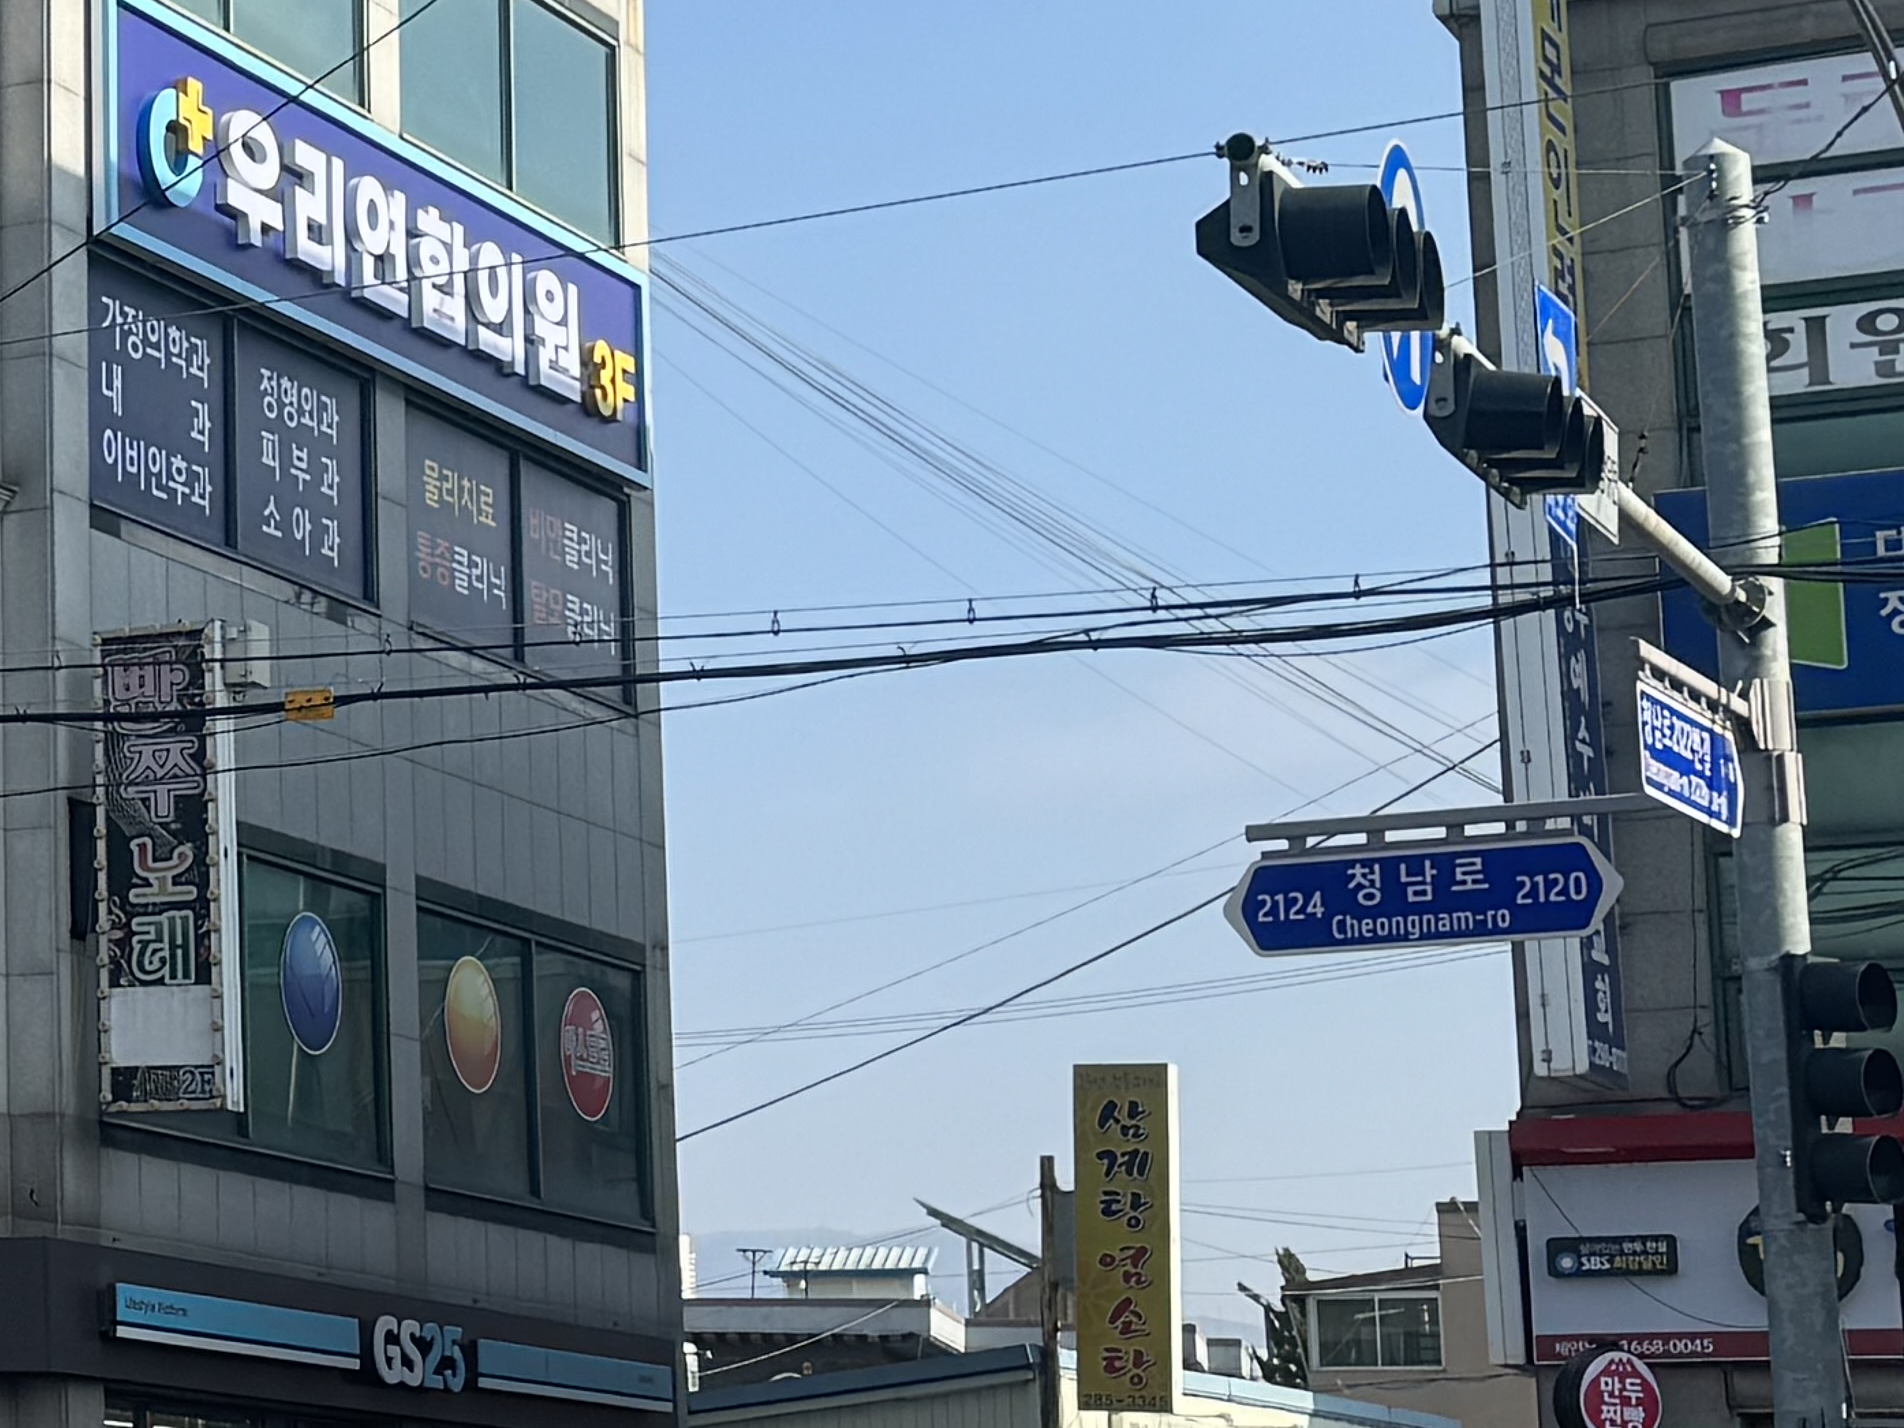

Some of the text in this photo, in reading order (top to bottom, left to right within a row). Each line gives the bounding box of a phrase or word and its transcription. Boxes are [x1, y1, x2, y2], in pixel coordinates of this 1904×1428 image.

[214, 107, 583, 404] 우리연합의원
[99, 294, 212, 391] 가정의학과
[586, 338, 638, 422] 3F
[100, 368, 213, 454] 내과
[259, 367, 341, 447] 정형외과
[102, 429, 214, 517] 이비인후과
[259, 429, 341, 507] 피부과
[422, 458, 499, 529] 물리치료
[261, 496, 342, 570] 소아과
[415, 530, 508, 610] 통증클리닉
[128, 836, 198, 985] 노래
[1256, 855, 1589, 923] 2124 청남로 2120
[1330, 905, 1512, 940] Cheongnam-ro
[1096, 1097, 1153, 1233] 삼계탕
[1580, 1254, 1611, 1271] SBS
[372, 1314, 465, 1394] GS25
[1097, 1242, 1159, 1392] 염소탕
[1599, 1375, 1644, 1406] 만두
